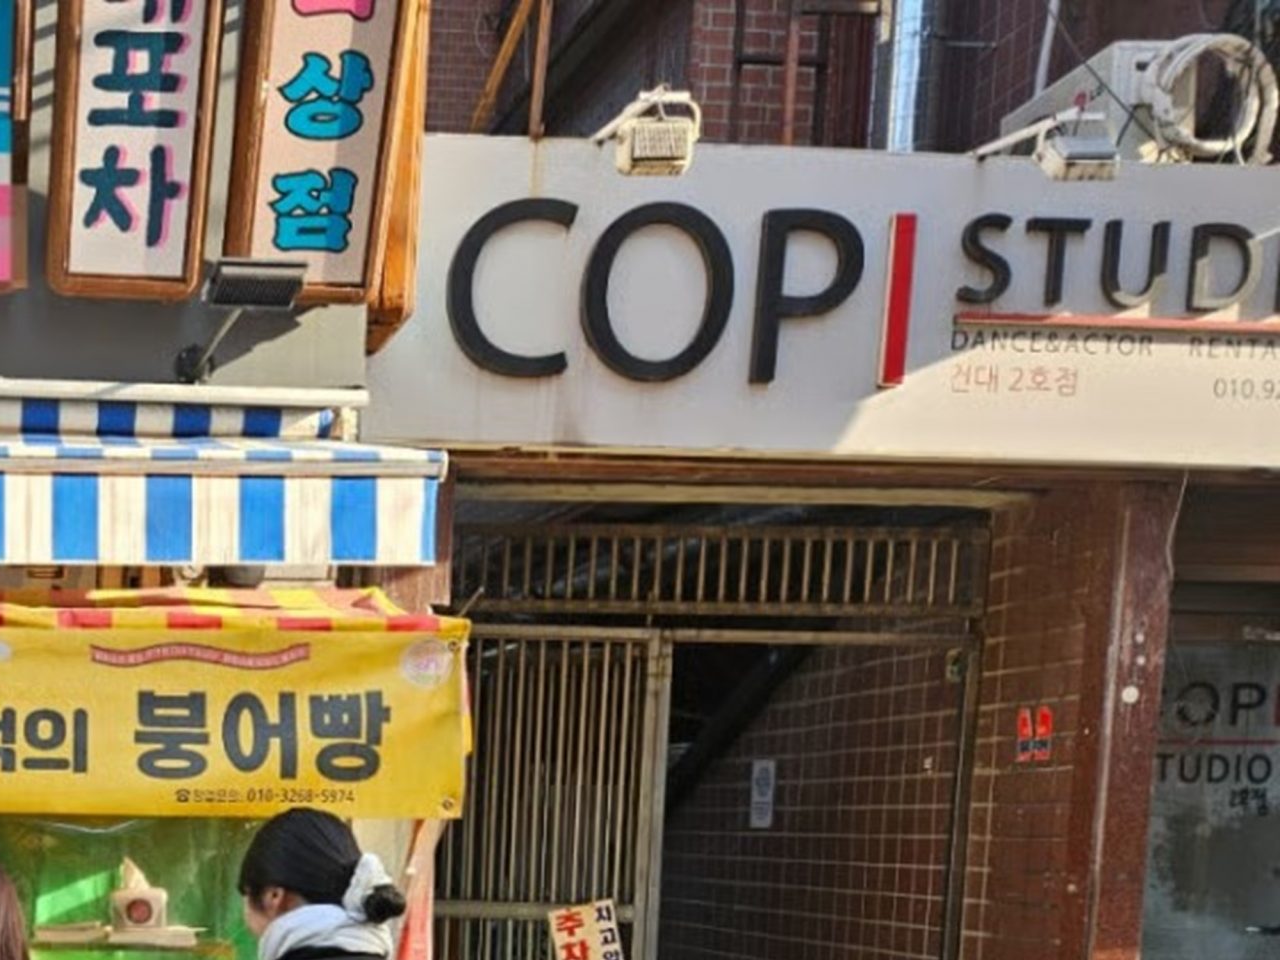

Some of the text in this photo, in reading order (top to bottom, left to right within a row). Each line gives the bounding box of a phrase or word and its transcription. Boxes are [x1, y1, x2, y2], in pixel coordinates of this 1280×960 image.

[79, 0, 186, 248] 포차
[268, 0, 373, 252] 상점
[447, 197, 917, 387] COPI
[956, 213, 1280, 312] STUD
[951, 328, 1154, 357] DANCE&ACTOR
[951, 364, 1078, 397] 건대 2호점
[133, 689, 393, 783] 붕어빵
